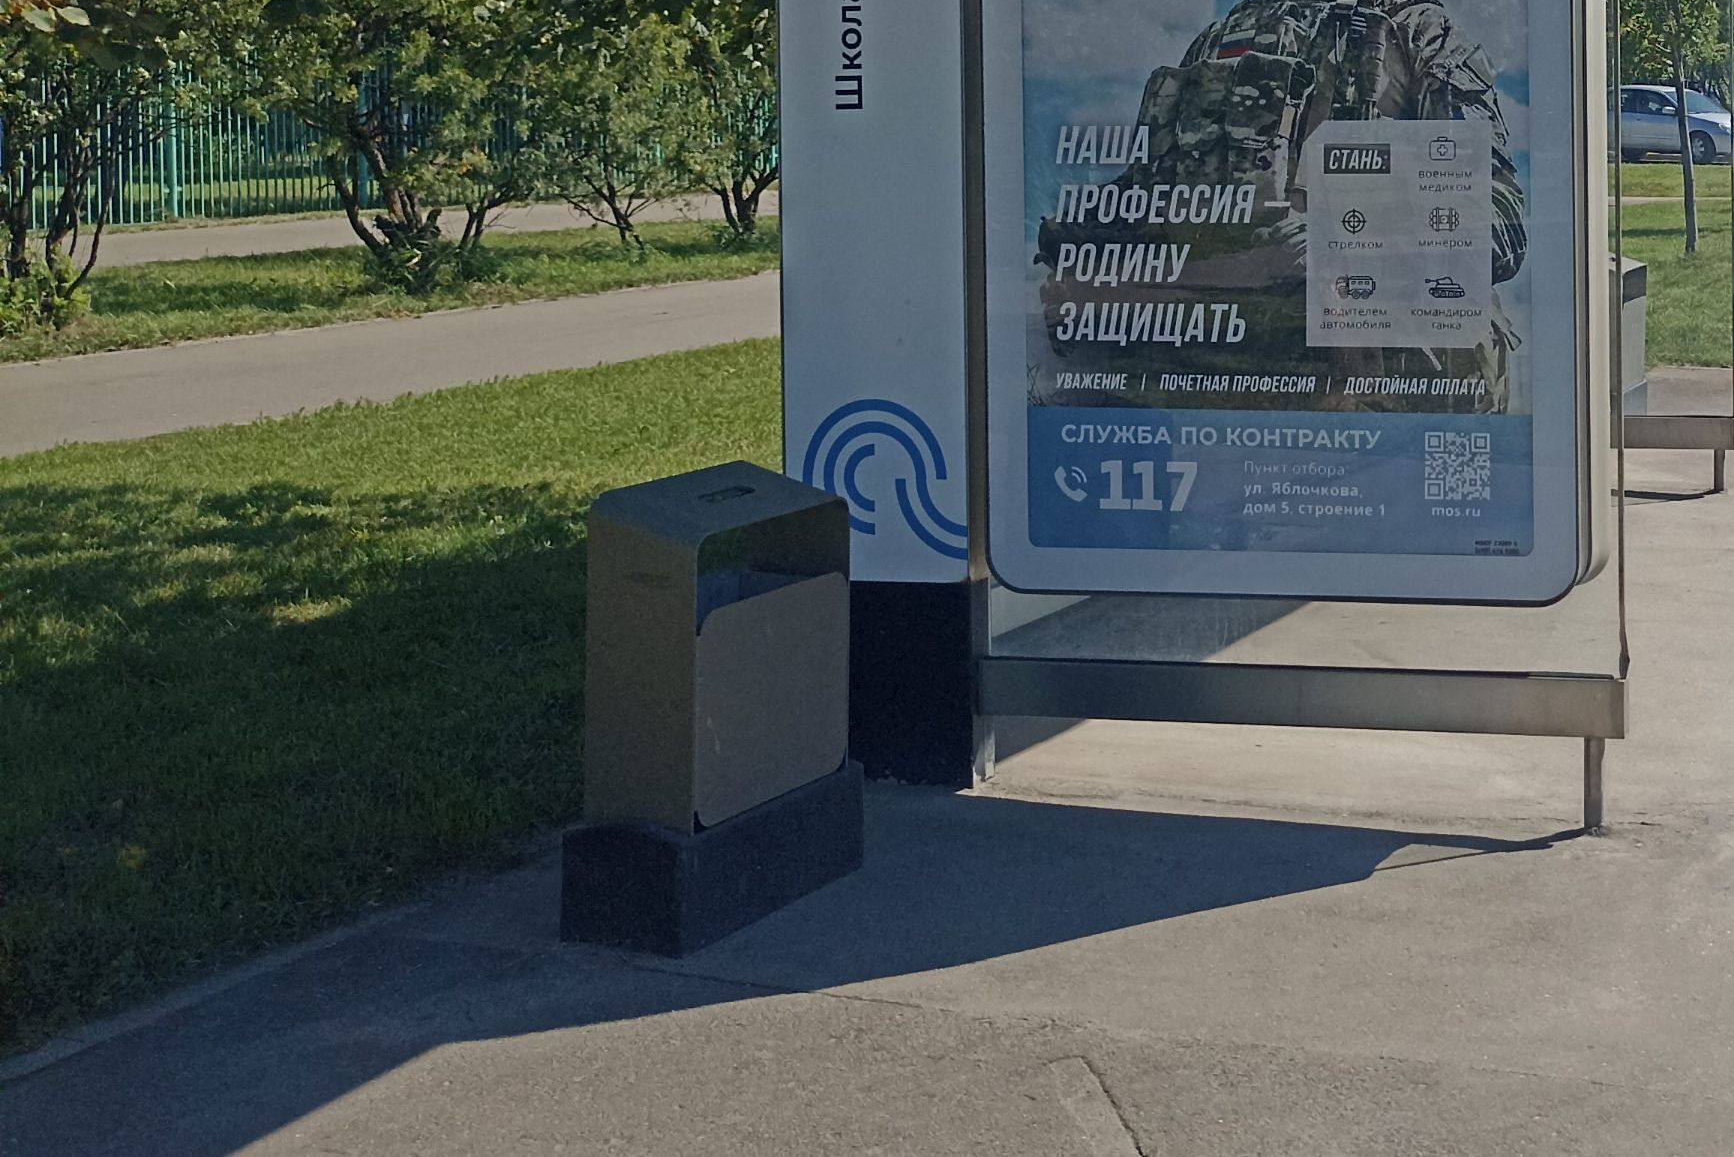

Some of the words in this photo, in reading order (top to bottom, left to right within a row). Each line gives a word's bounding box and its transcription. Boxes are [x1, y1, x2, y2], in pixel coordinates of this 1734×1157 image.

[1055, 125, 1149, 164] НАША
[1328, 148, 1388, 171] СТАНЬ:
[1418, 170, 1473, 179] военным
[1419, 184, 1472, 193] медиком
[1055, 184, 1257, 224] ПРОФЕССИЯ
[1328, 240, 1383, 251] стрелком
[1418, 239, 1473, 250] минером
[1055, 243, 1191, 287] РОДИНУ
[1323, 307, 1388, 318] водителем
[1410, 308, 1482, 318] командиром
[1056, 302, 1247, 347] ЗАЩИЩАТЬ
[1319, 320, 1391, 330] автомобиля
[1431, 322, 1462, 331] танка
[1055, 372, 1128, 391] УВАЖЕНИЕ
[1159, 373, 1229, 392] ПОЧЕТНАЯ
[1232, 375, 1316, 393] ПРОФЕССИЯ
[1344, 374, 1427, 396] ДОСТОЙНАЯ
[1430, 377, 1486, 396] ОПЛАТА
[1061, 424, 1172, 445] СЛУЖБА
[1181, 426, 1218, 446] ПО
[1226, 426, 1382, 450] КОНТРАКТУ
[1243, 460, 1287, 476] Пункт
[1099, 459, 1198, 512] 117
[1243, 503, 1276, 516] дом
[1298, 503, 1374, 518] строение
[1378, 504, 1386, 517] 1
[1431, 506, 1481, 518] mos.ru
